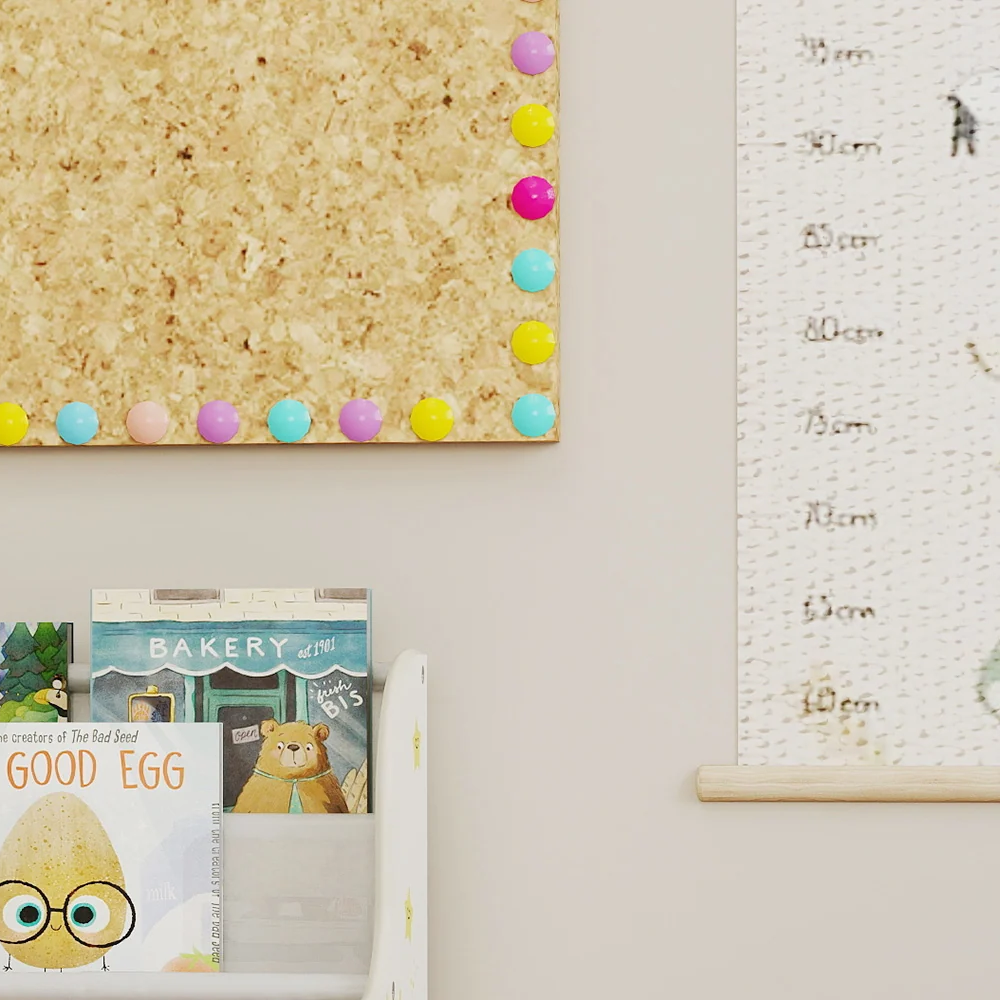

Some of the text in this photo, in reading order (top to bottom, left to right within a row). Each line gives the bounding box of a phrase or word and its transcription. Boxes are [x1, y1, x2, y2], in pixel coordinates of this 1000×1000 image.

[149, 636, 336, 659] BAKERY est 1901
[317, 680, 352, 704] fresh
[321, 690, 364, 719] BIS
[12, 731, 53, 743] creators
[57, 731, 67, 743] of
[72, 729, 89, 743] The
[92, 729, 111, 743] Bad
[114, 729, 139, 743] Seed
[234, 727, 258, 742] open
[6, 749, 97, 790] GOOD
[120, 750, 185, 790] EGG
[147, 881, 178, 901] milk
